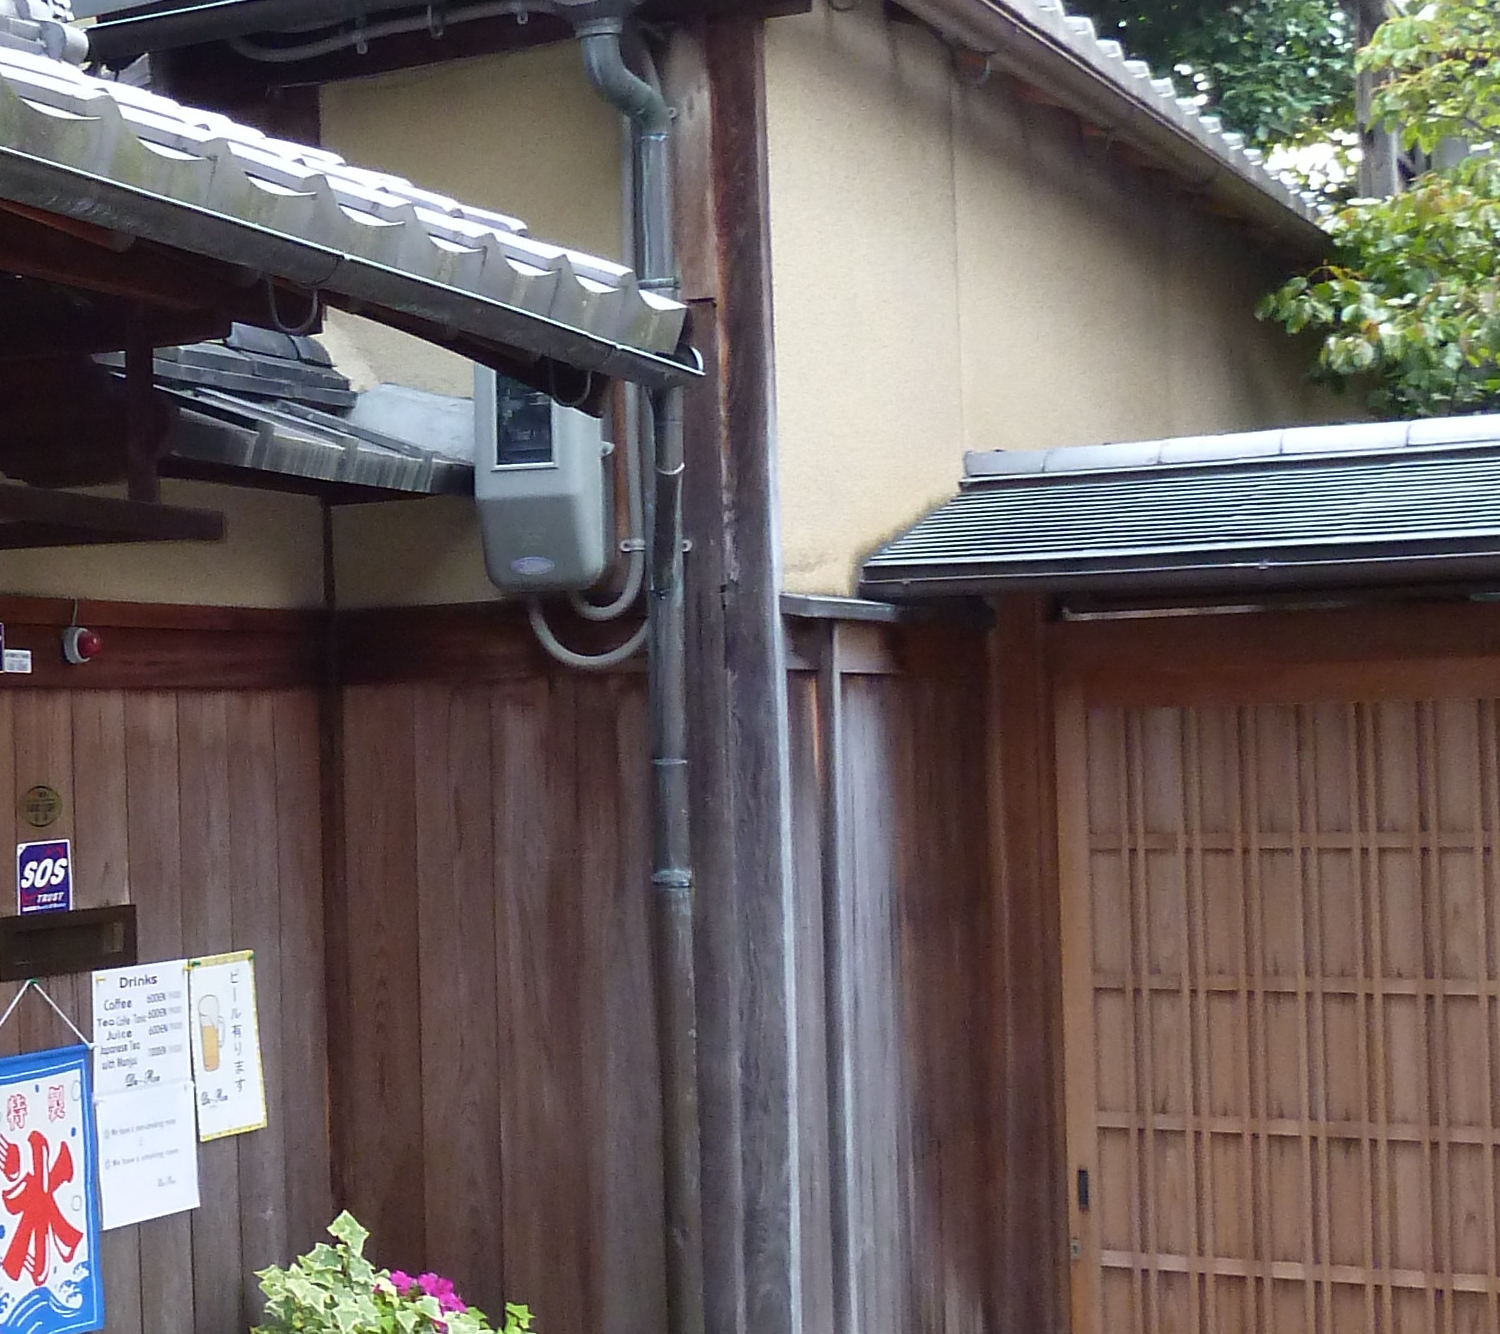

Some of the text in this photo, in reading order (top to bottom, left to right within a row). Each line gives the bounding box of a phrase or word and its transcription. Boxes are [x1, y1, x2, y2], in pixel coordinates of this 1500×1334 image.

[21, 857, 68, 889] SOS
[36, 891, 65, 903] TRUST
[119, 974, 158, 989] Drinks
[103, 997, 133, 1011] Coffee
[96, 1018, 115, 1027] Tea
[106, 1029, 133, 1041] Juice
[229, 969, 246, 1093] ビール有ります
